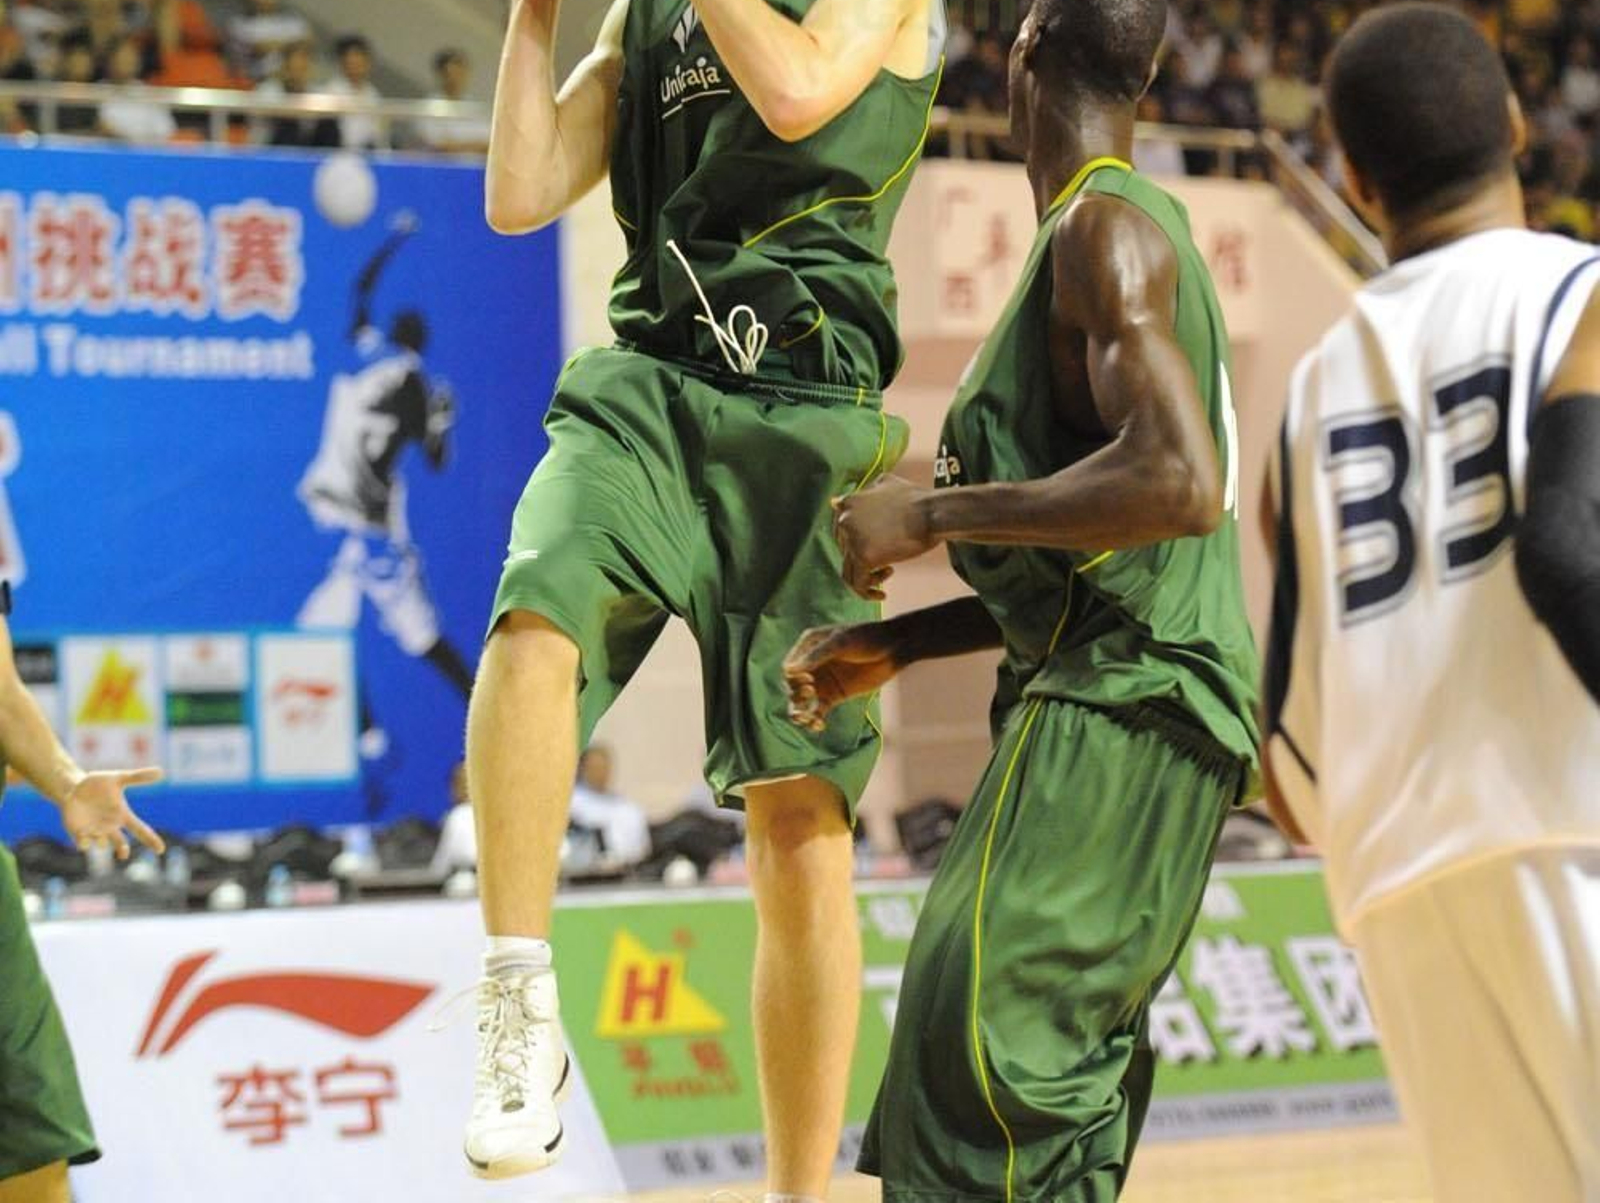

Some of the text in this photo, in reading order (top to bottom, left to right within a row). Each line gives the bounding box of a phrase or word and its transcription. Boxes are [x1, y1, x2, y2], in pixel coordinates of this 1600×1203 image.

[0, 191, 304, 323] 挑战赛
[42, 324, 314, 379] Tournament
[1321, 354, 1518, 629] 33
[215, 1057, 399, 1149] 李宁
